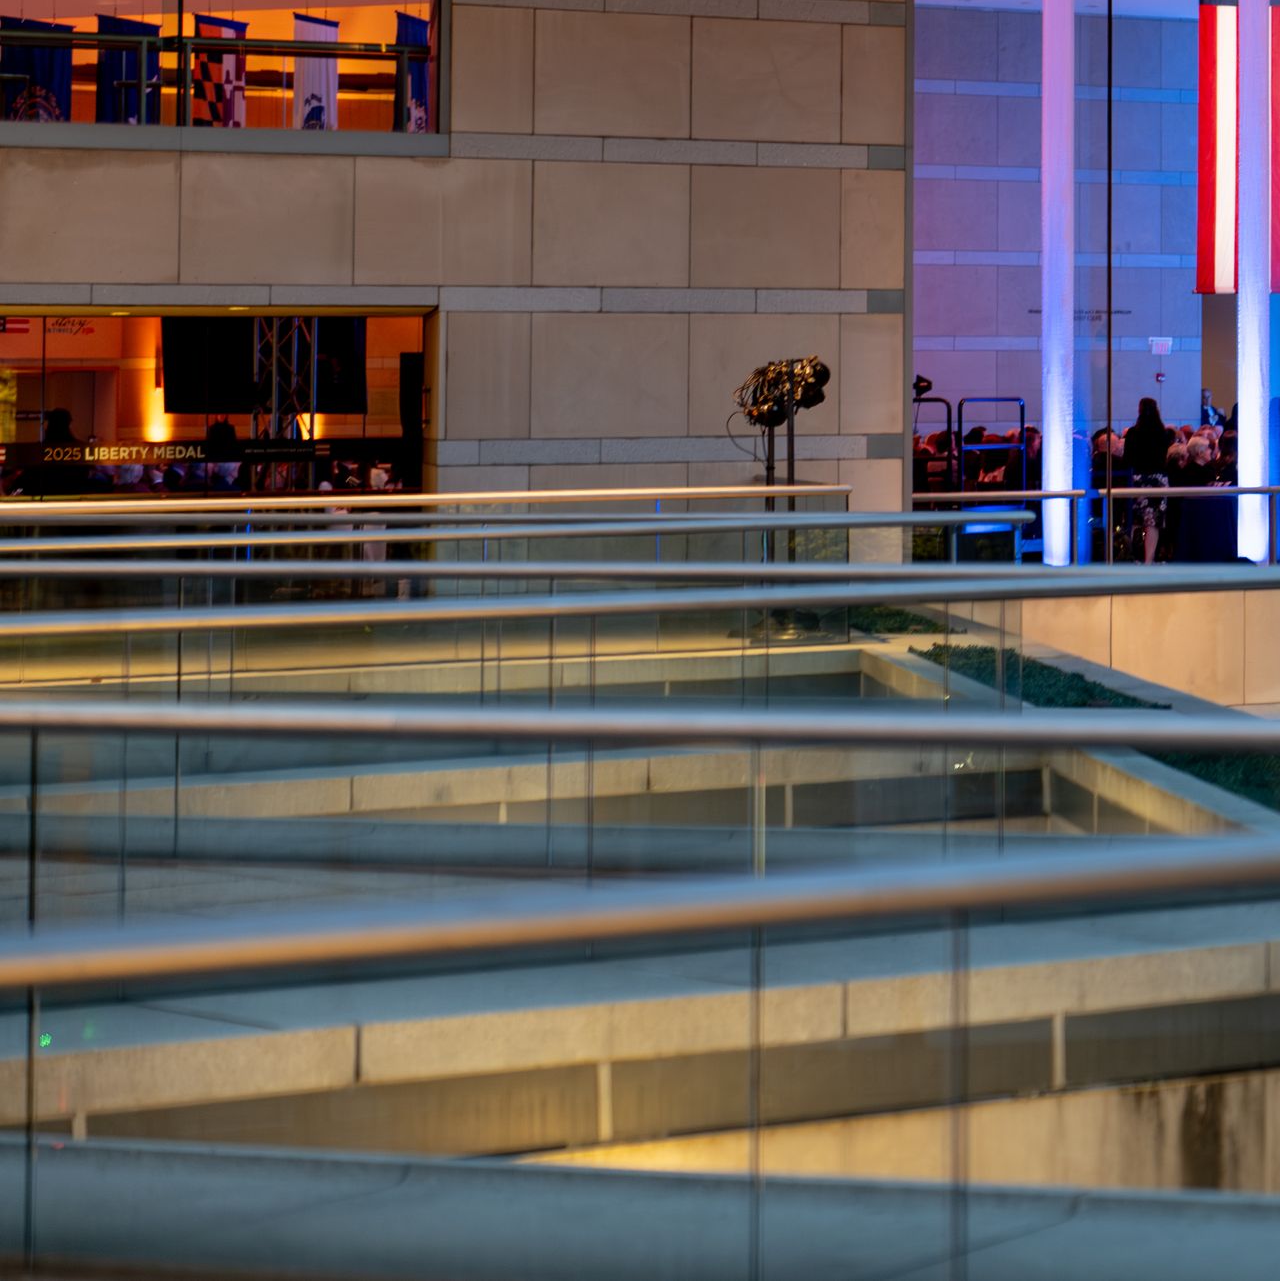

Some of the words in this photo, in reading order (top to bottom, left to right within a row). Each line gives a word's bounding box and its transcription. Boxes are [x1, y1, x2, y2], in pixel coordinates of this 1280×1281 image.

[45, 447, 81, 461] 2025
[85, 446, 149, 461] LIBERTY
[153, 445, 206, 460] MEDAL
